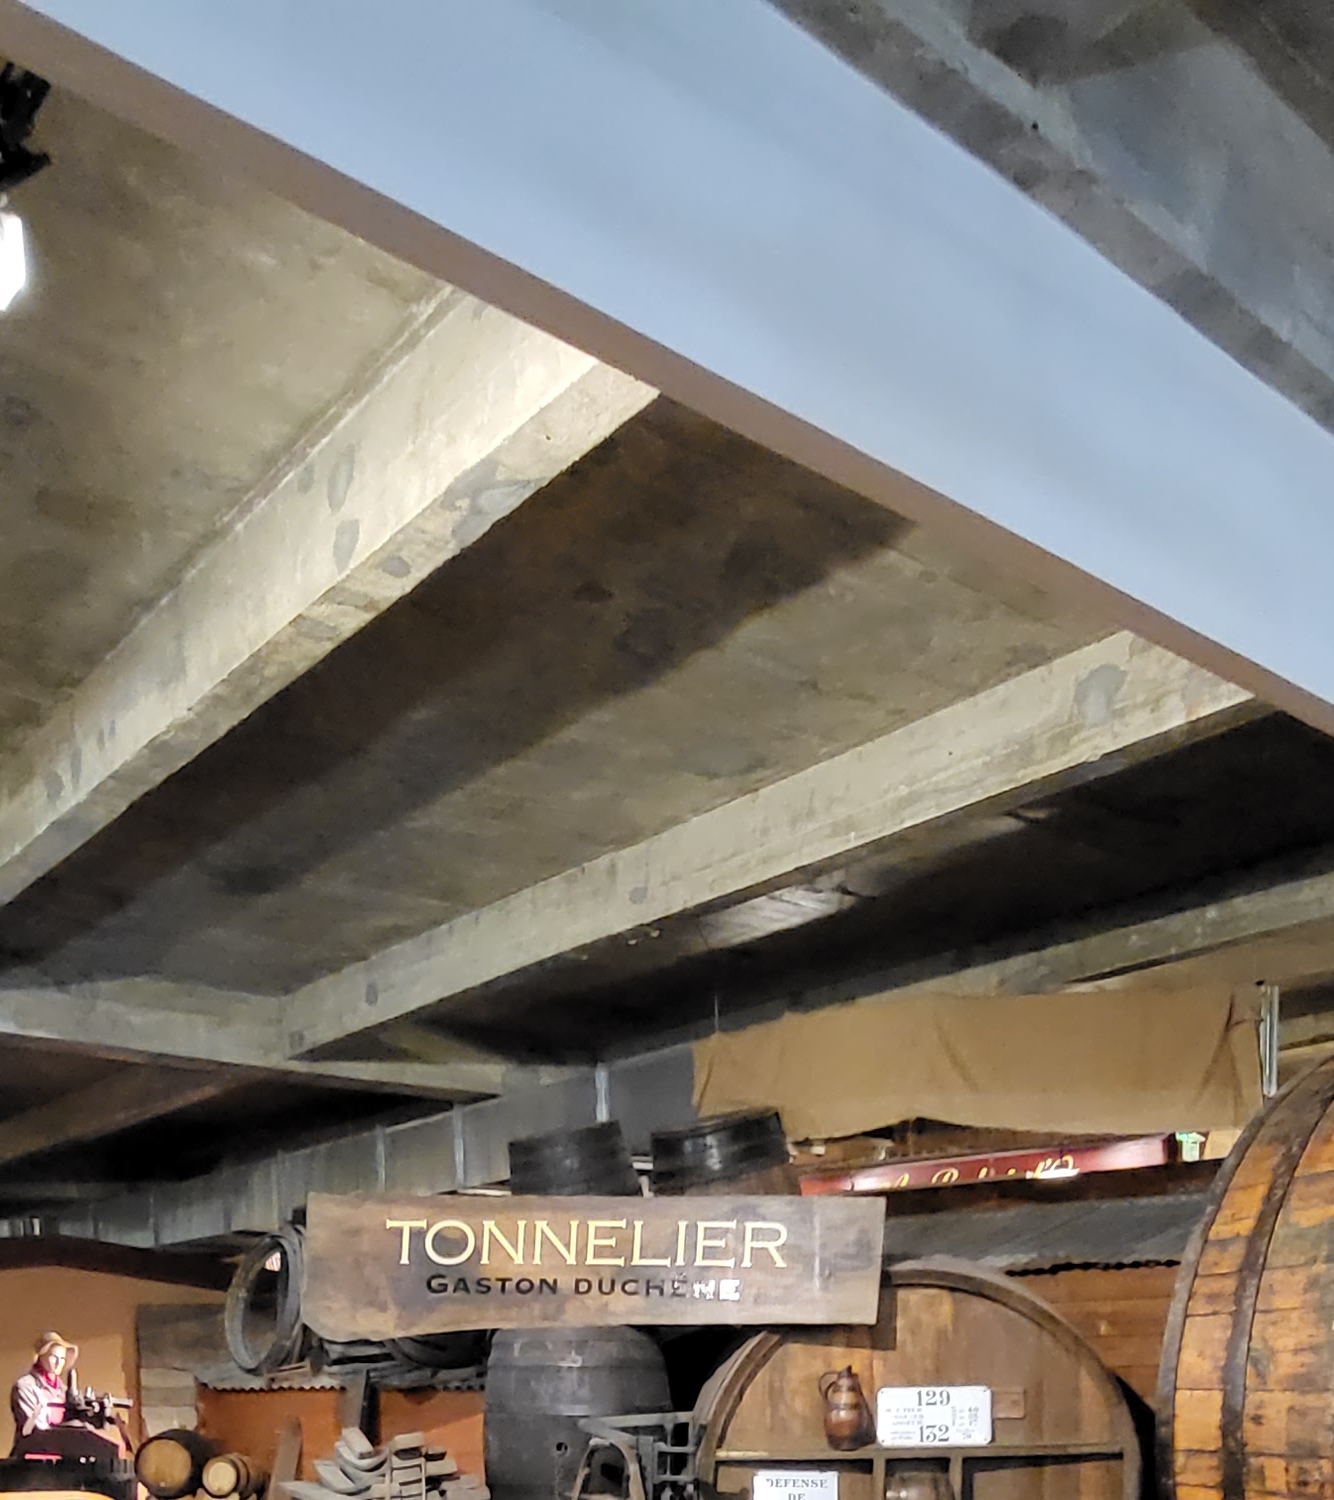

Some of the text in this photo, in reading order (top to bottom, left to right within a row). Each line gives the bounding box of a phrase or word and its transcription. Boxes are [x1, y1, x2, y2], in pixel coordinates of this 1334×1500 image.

[385, 1218, 789, 1269] TONNELIER
[425, 1274, 559, 1296] GASTON
[916, 1389, 951, 1407] 129
[919, 1424, 950, 1443] 132
